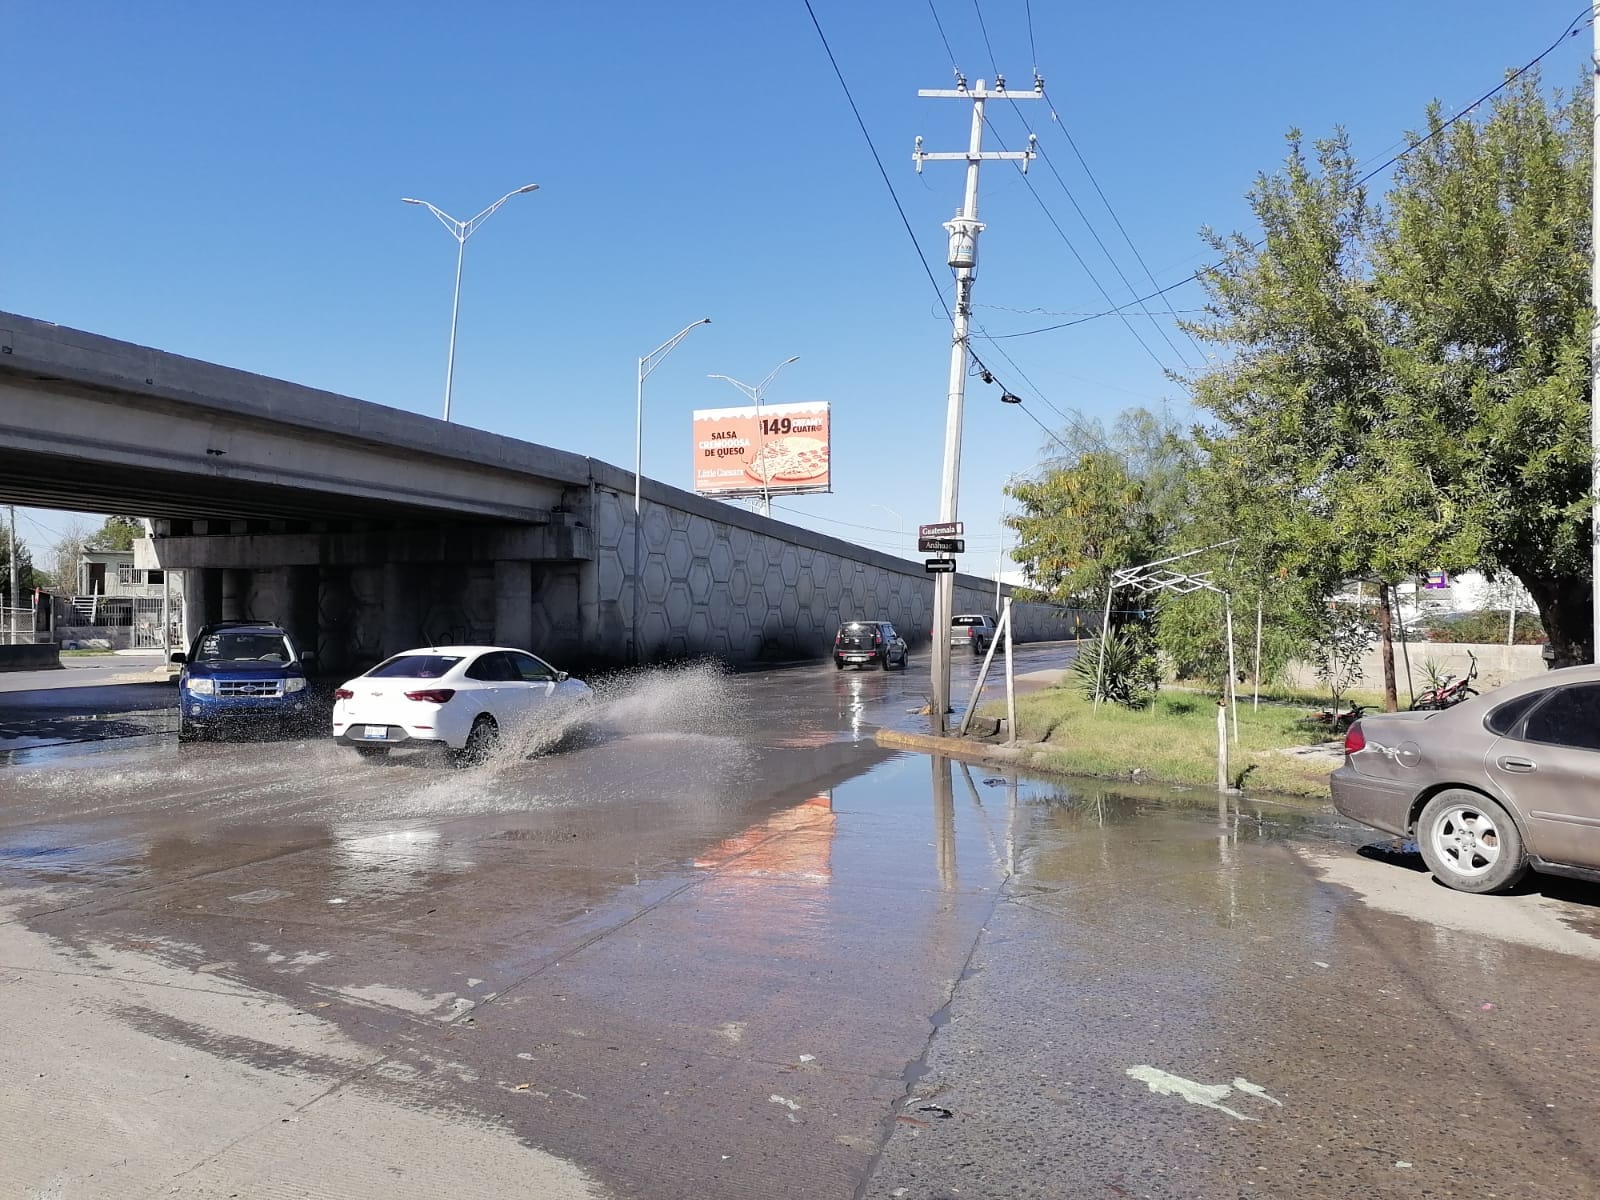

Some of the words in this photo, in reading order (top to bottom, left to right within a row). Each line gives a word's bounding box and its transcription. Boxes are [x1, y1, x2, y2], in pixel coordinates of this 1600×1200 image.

[712, 431, 737, 440] SALSA
[705, 449, 715, 457] DE
[717, 447, 744, 458] QUESO
[922, 526, 955, 535] Guatemala
[925, 541, 952, 549] Anáhuac
